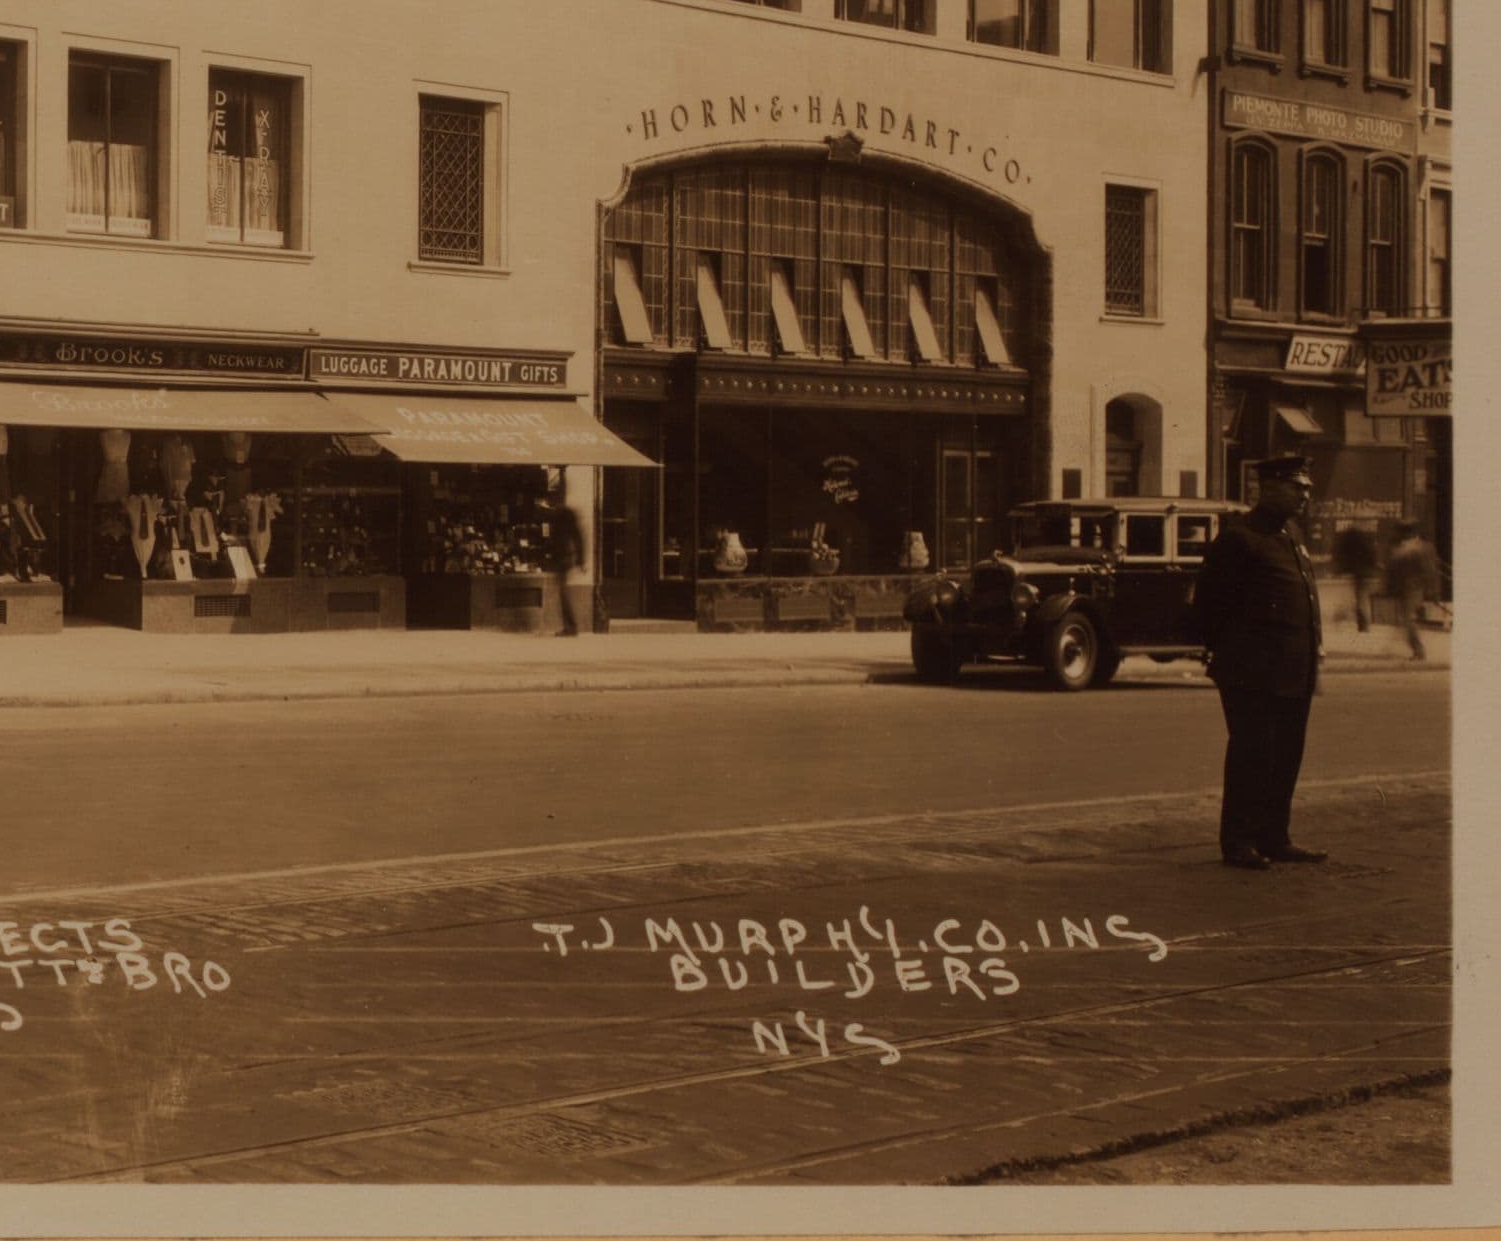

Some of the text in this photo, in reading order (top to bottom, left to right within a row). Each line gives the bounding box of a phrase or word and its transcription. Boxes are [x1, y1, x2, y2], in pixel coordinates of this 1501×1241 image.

[641, 94, 748, 141] HORN
[769, 94, 785, 122] &
[807, 95, 961, 157] HARDART
[1233, 94, 1300, 121] PIEMONTE
[1306, 106, 1347, 129] PHOTO
[1356, 116, 1403, 139] STUDIO
[55, 341, 164, 366] Brook's
[207, 352, 285, 369] NECKWEAR
[321, 356, 559, 382] LUGGAGE PARAMOUNT GIFTS
